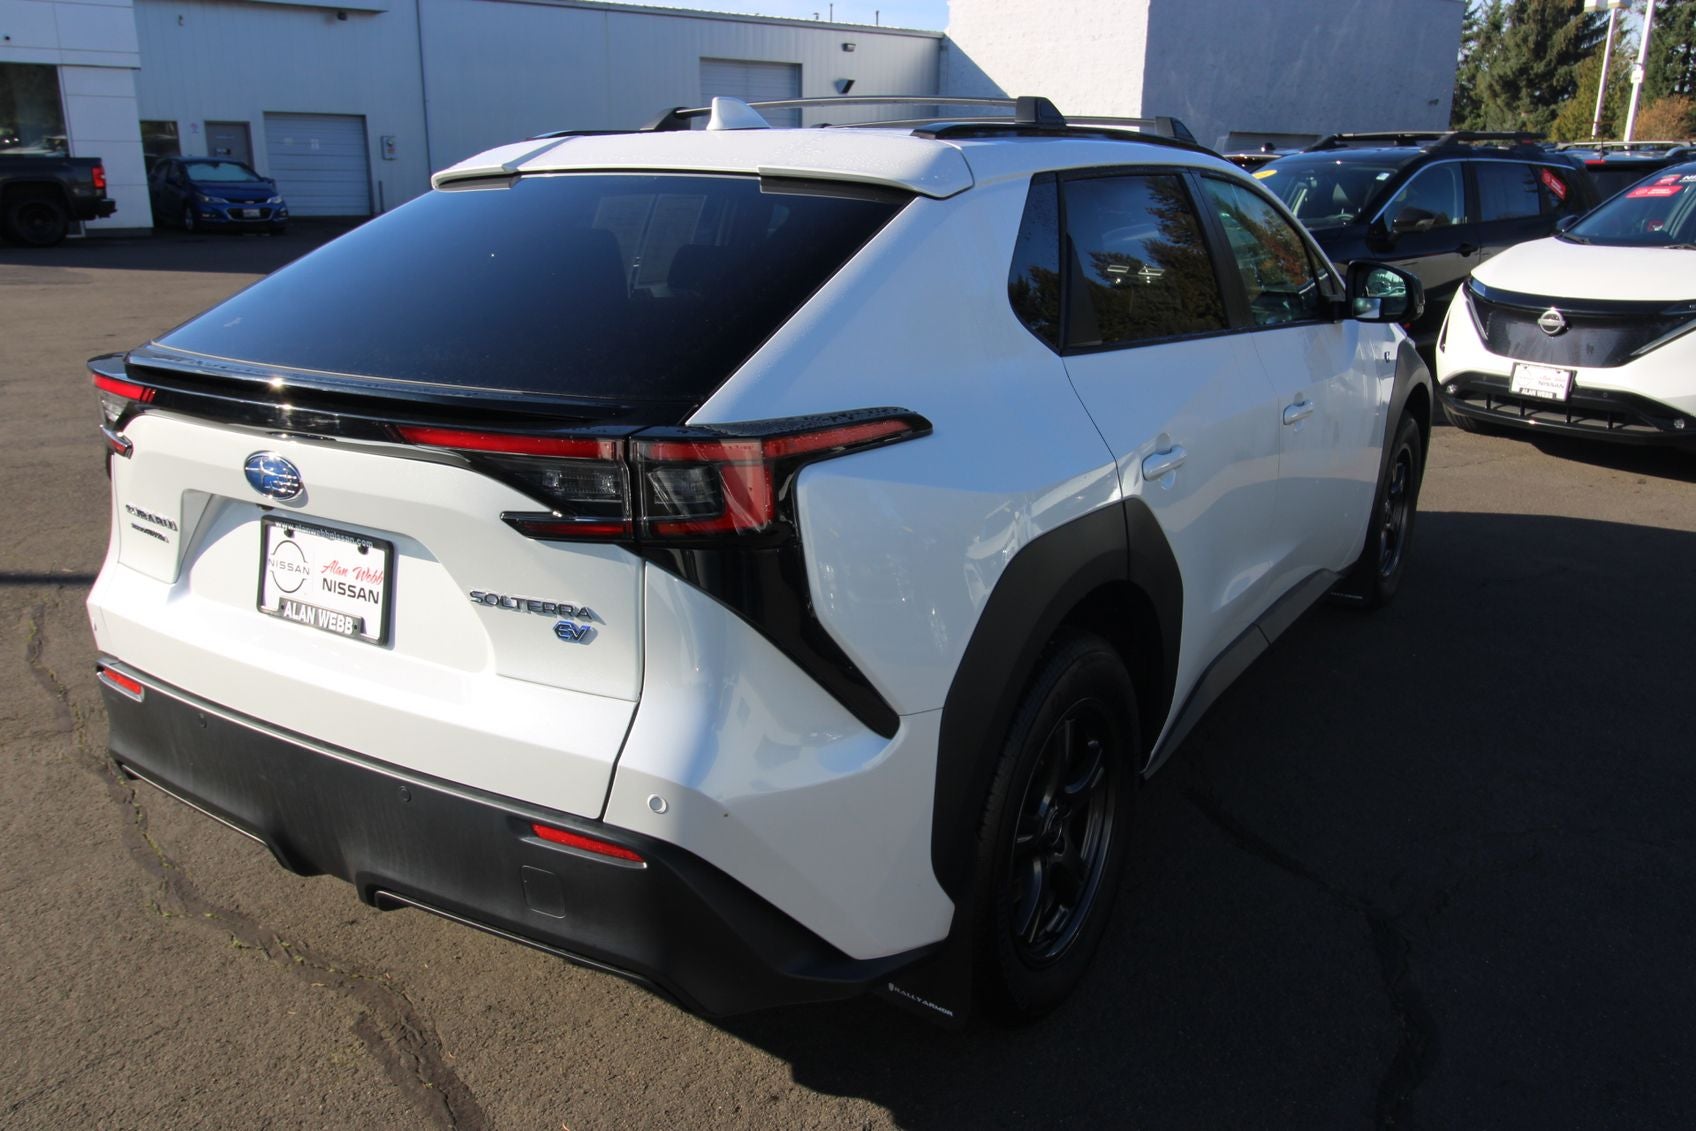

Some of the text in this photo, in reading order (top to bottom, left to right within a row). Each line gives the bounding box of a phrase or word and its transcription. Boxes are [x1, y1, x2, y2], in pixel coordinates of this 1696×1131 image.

[268, 557, 310, 576] NISSAN
[321, 559, 384, 586] Alan Webb
[322, 577, 380, 605] NISSAN
[283, 600, 354, 635] ALAN WEBB
[469, 590, 593, 621] SOLTERRA
[553, 620, 591, 642] EV
